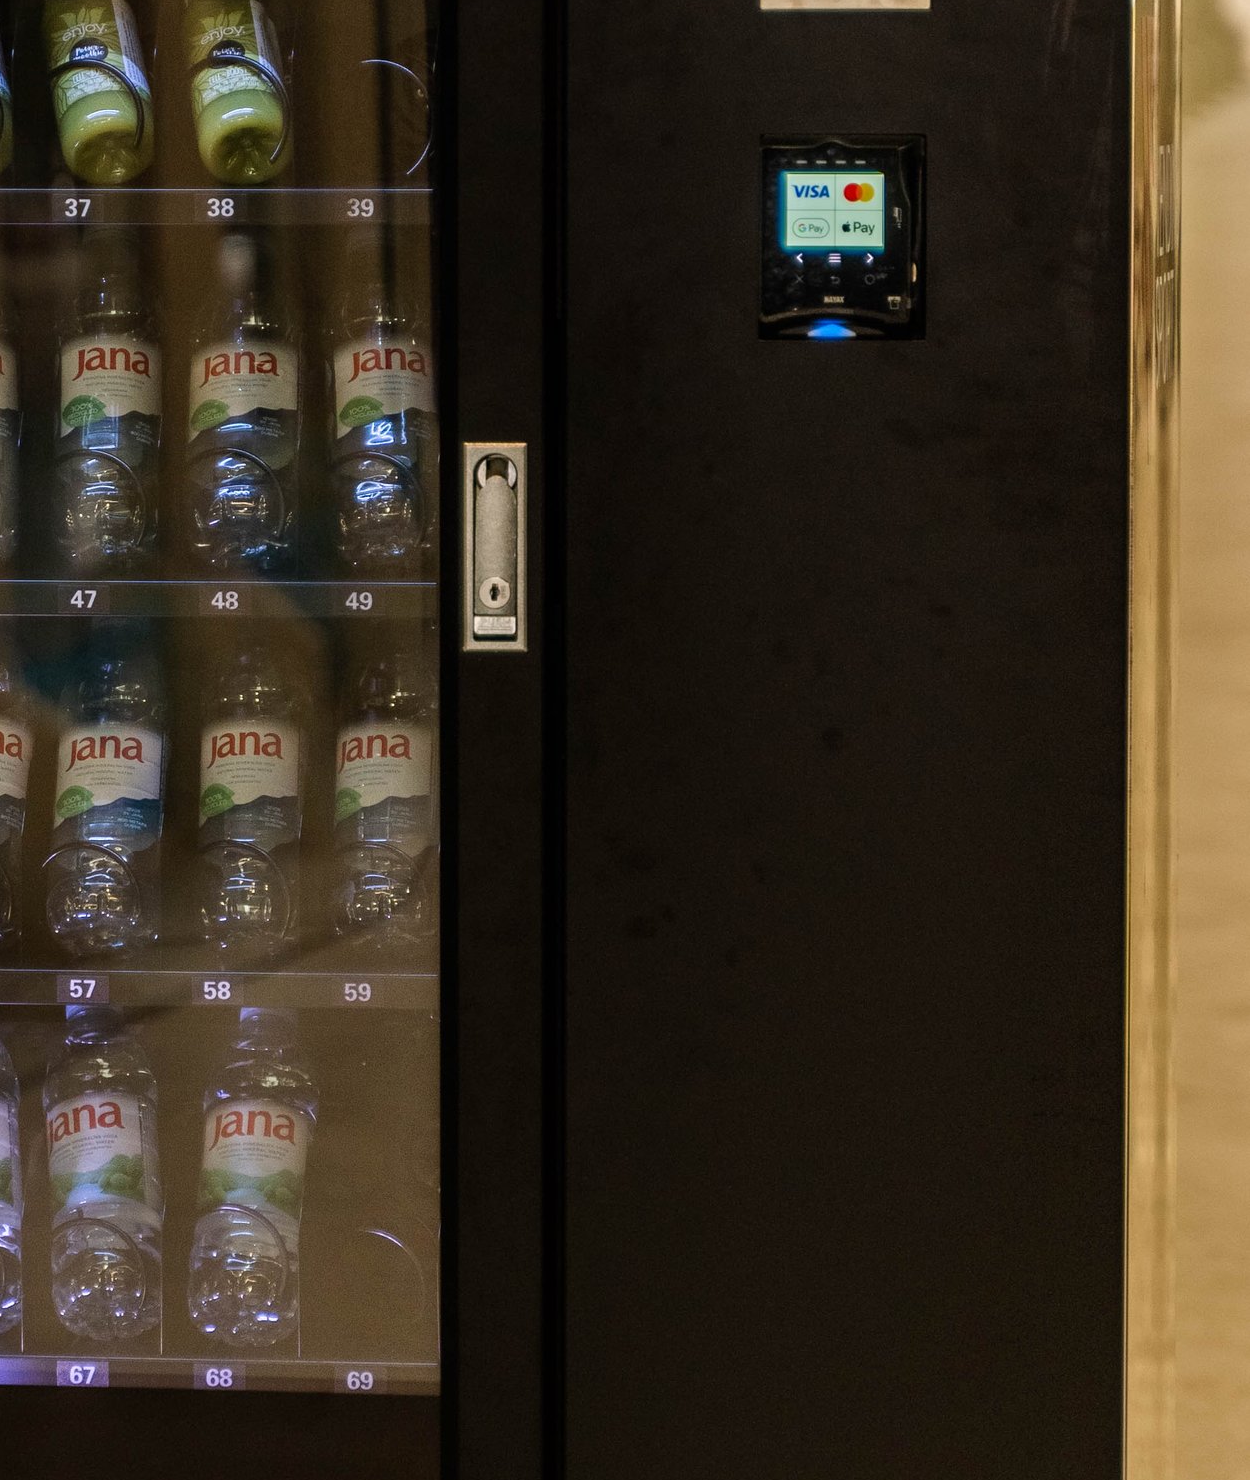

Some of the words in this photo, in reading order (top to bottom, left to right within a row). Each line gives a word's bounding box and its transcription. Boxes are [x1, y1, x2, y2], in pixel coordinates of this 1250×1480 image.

[791, 185, 830, 198] VISA
[65, 198, 91, 217] 37
[207, 198, 234, 217] 38
[348, 199, 374, 217] 39
[808, 224, 824, 234] Pay
[853, 222, 875, 235] Pay
[72, 347, 150, 381] jana
[200, 351, 280, 388] jana
[347, 348, 427, 383] jana
[71, 590, 96, 608] 47
[211, 591, 238, 609] 48
[346, 592, 373, 610] 49
[66, 735, 144, 772] jana
[207, 731, 283, 768] jana
[338, 734, 412, 774] jana
[70, 979, 95, 998] 57
[204, 981, 231, 1000] 58
[344, 983, 371, 1001] 59
[209, 1110, 295, 1151] jana
[70, 1366, 96, 1385] 67
[205, 1367, 233, 1387] 68
[346, 1370, 374, 1390] 69
